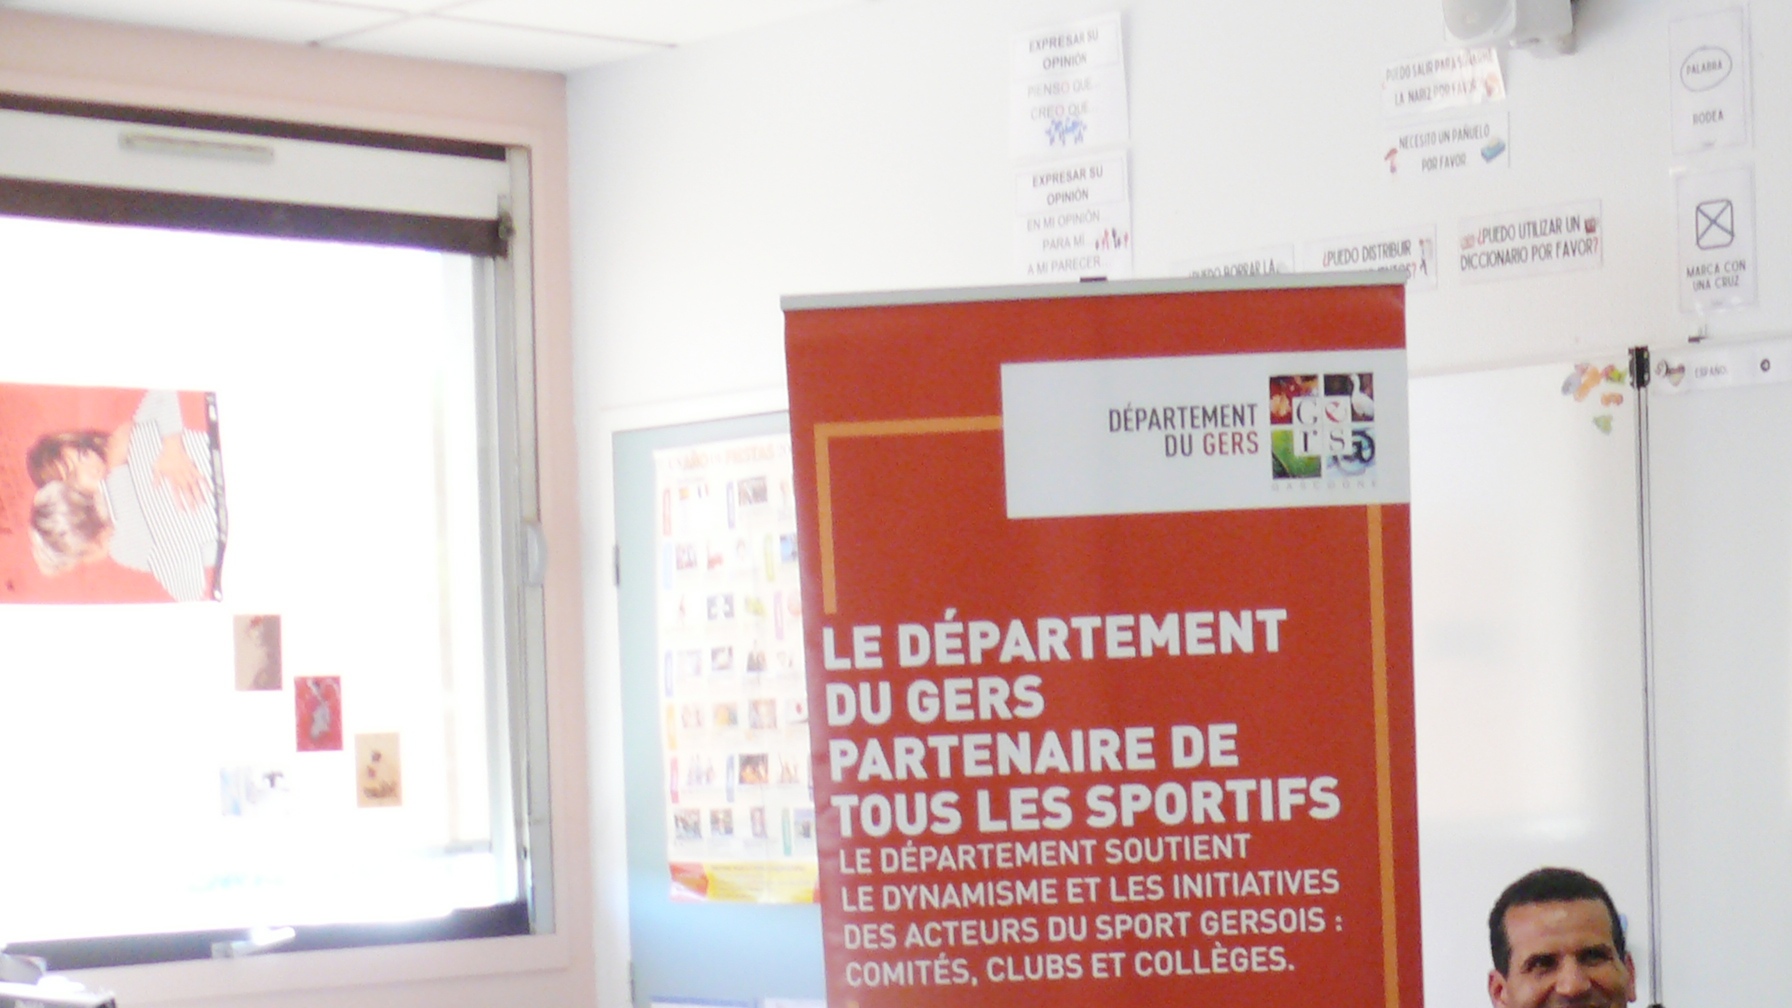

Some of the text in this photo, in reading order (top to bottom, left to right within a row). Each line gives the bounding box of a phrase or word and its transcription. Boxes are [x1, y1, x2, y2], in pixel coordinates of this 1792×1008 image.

[1029, 28, 1098, 53] EXPRESAR SU
[1412, 58, 1434, 78] SALIR
[1686, 59, 1723, 75] PALABRA
[1394, 92, 1405, 107] LA
[1408, 85, 1431, 103] NARIZ
[1031, 102, 1065, 121] CREO
[1692, 109, 1724, 126] RODEA
[1399, 122, 1490, 149] NECESITO UN PAÑUELO
[1421, 152, 1467, 172] POR FAVOR
[1032, 165, 1103, 188] EXPRESAR SU
[1046, 187, 1089, 206] OPINIÓN
[1477, 214, 1581, 246] ¿PUEDO UTILIZAR UN
[1322, 239, 1412, 268] ¿PUEDO DISTRIBUIR
[1460, 236, 1599, 272] DICCIONARIO POR FAVOR?
[1686, 258, 1747, 281] MARCA CON
[1692, 273, 1740, 292] UNA CRUZ
[1109, 402, 1258, 434] DÉPARTEMENT
[1165, 431, 1260, 458] DU GERS
[822, 608, 1288, 671] LE DÉPARTEMENT
[826, 676, 1045, 726] DU GERS
[830, 723, 1239, 783] PARTENAIRE DE
[832, 776, 1341, 838] TOUS LES SPORTIFS
[840, 833, 1252, 875] LE DÉPARTEMENT SOUTIENT
[841, 869, 1341, 912] LE DYNAMISME ET LES INITIATIVES
[844, 923, 898, 950] DES
[904, 915, 1040, 947] ACTEURS
[1048, 915, 1088, 942] DU
[1096, 912, 1192, 941] SPORT
[1200, 907, 1326, 936] GERSOIS
[846, 941, 1296, 988] COMITÉS, CLUBS ET COLLÈGES.
